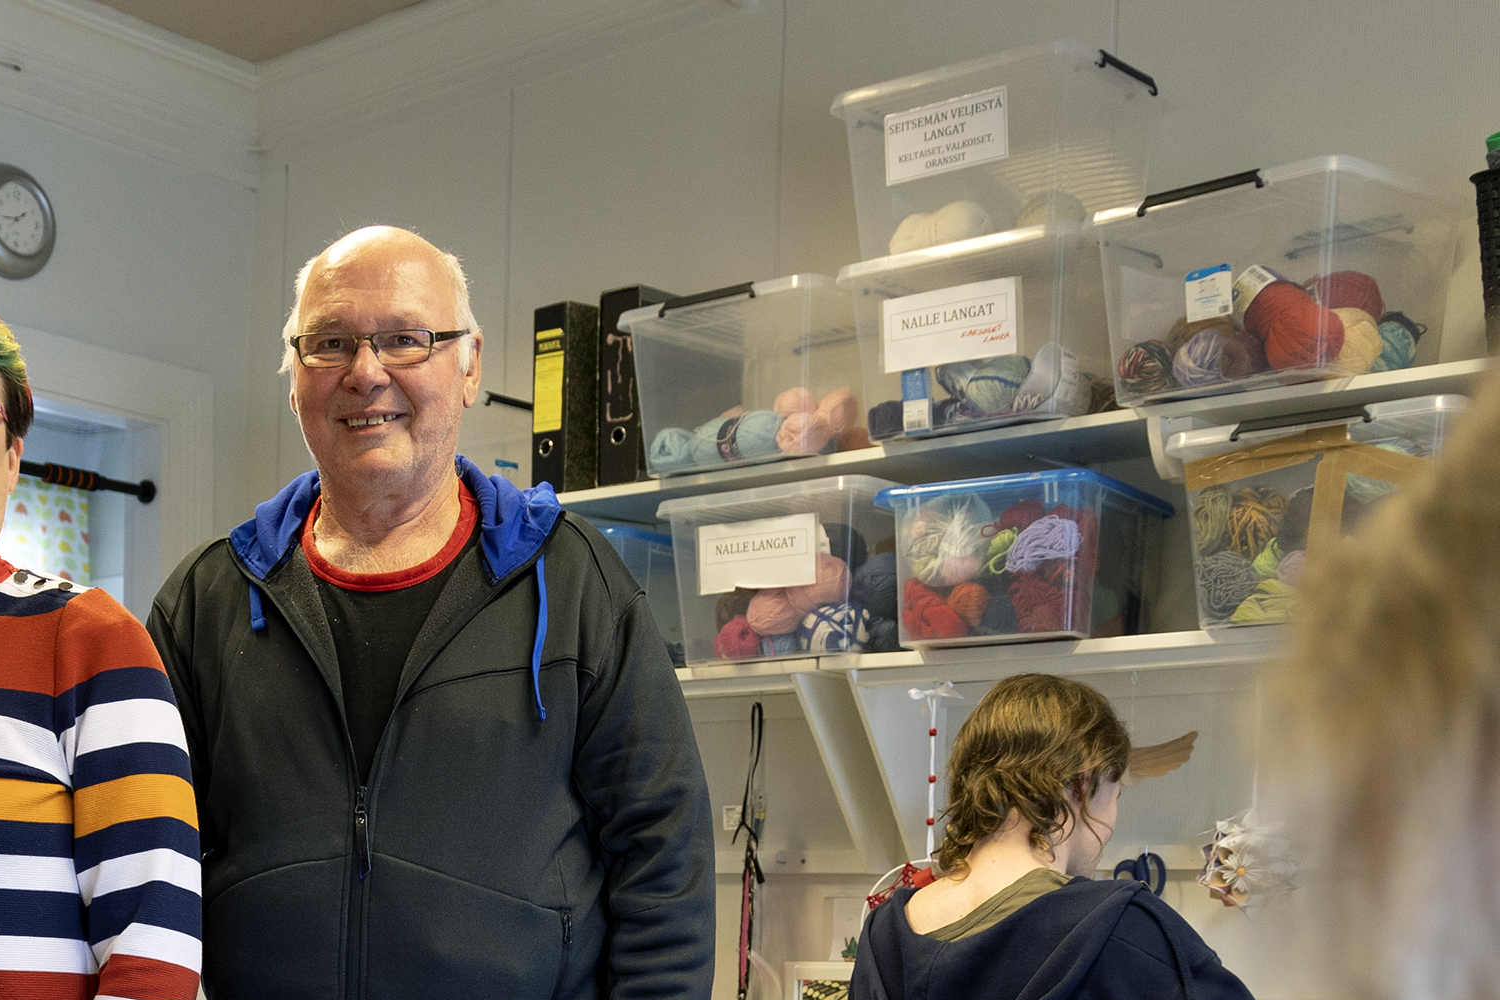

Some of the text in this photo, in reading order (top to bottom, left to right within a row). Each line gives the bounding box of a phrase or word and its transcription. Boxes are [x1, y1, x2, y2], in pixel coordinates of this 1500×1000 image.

[888, 96, 1003, 135] SEITSEMÄN VELJESTÄ
[923, 122, 967, 142] LANGAT
[898, 133, 995, 164] KELTAISET, VALKOISET,
[925, 152, 967, 169] ORANSSIT
[901, 302, 995, 331] NALLE LANGAT
[715, 536, 796, 556] NALLE LANGAT
